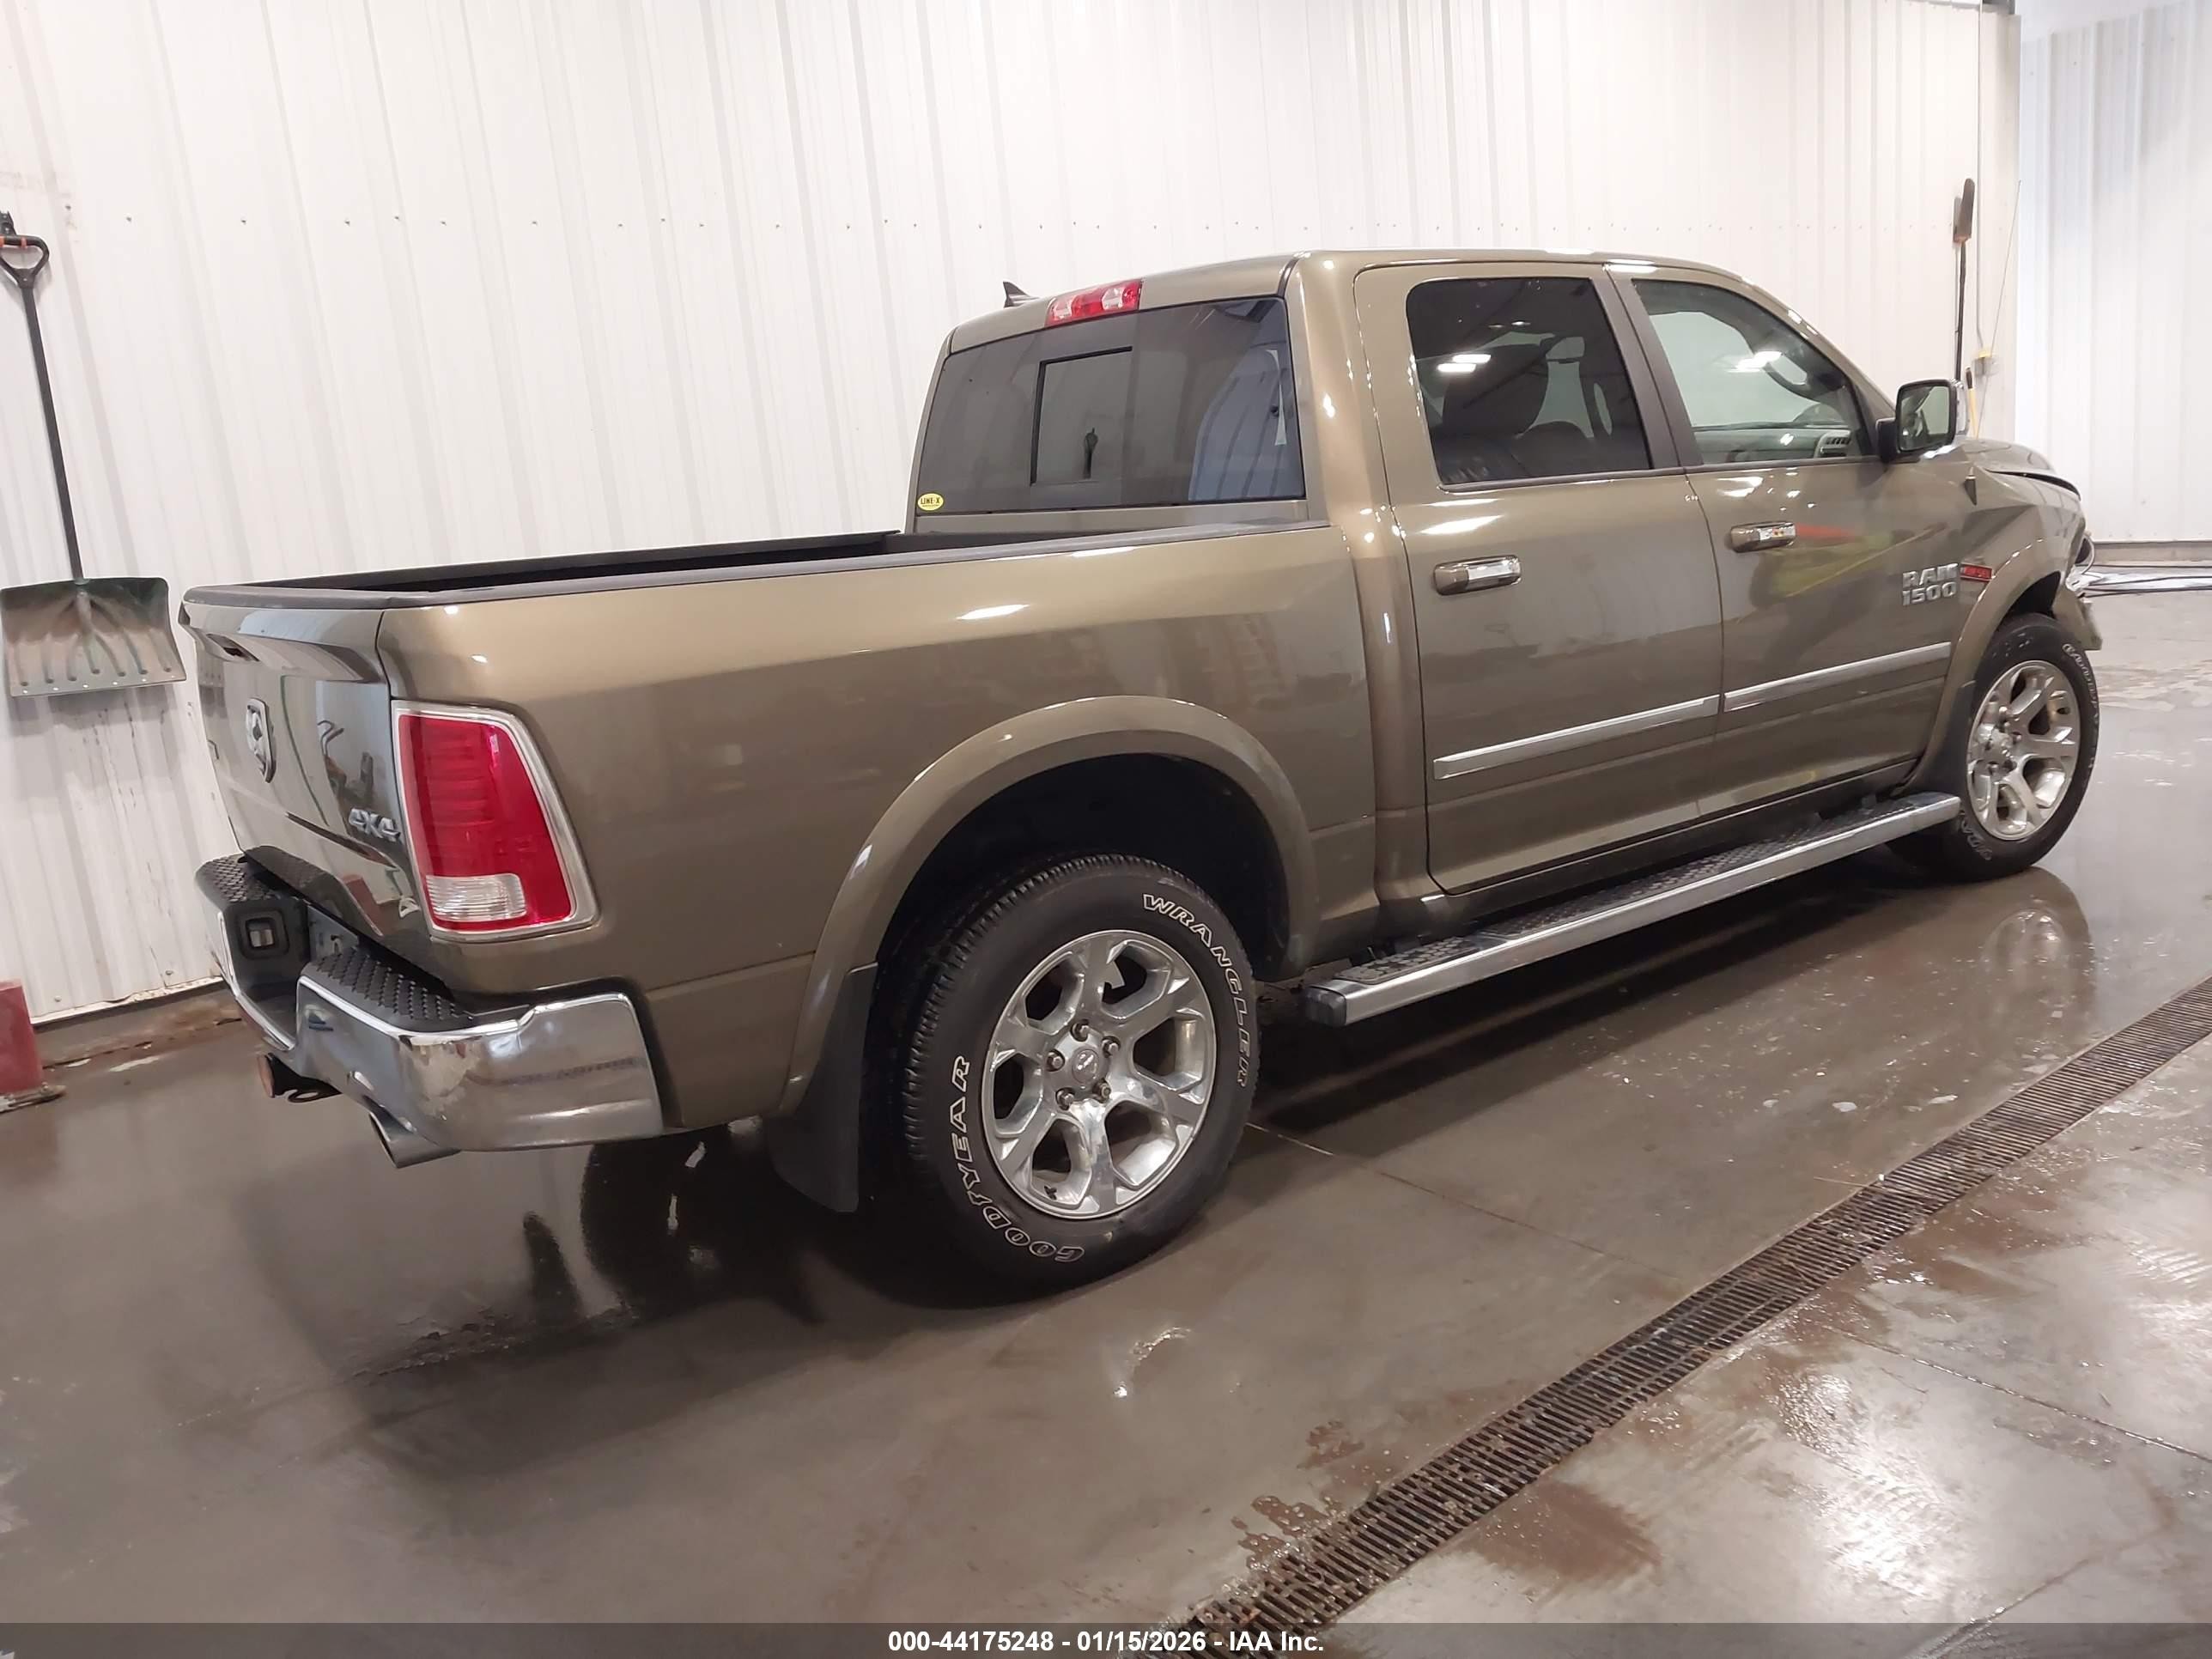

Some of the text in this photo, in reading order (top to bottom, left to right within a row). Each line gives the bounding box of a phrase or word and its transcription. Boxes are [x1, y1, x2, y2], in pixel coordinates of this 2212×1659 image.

[1902, 562, 1959, 588] RAM
[1902, 581, 1957, 606] 1500
[1143, 894, 1251, 1087] WRANGLER
[949, 1055, 1085, 1262] GOODYEAR
